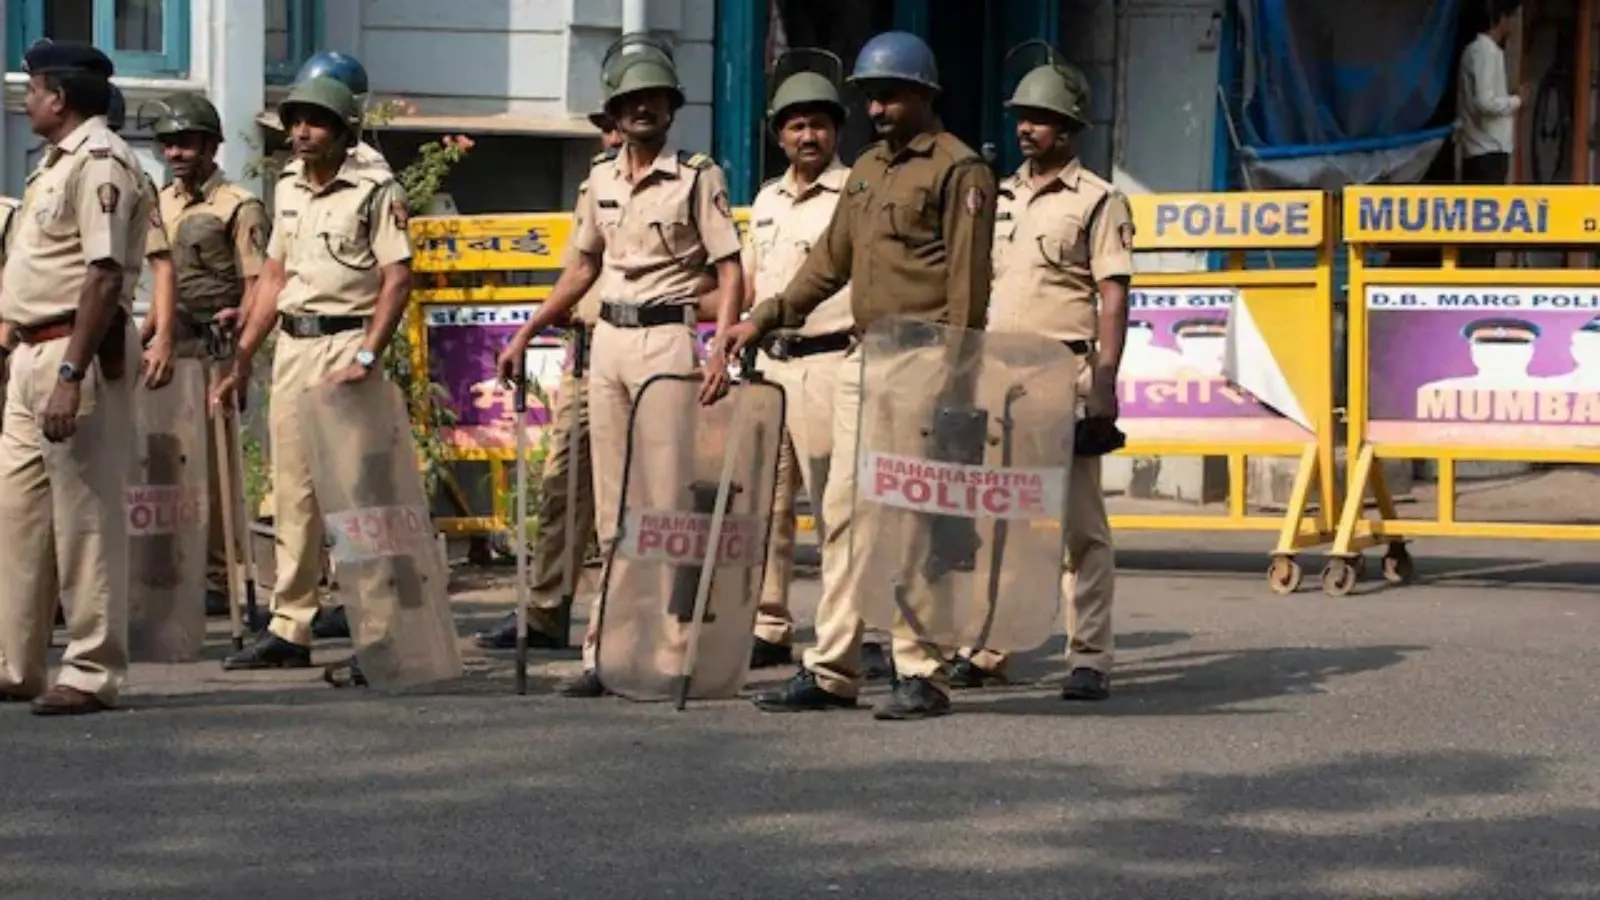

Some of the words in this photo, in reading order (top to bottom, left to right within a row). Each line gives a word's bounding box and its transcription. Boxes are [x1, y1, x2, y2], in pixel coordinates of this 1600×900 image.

[1155, 202, 1310, 237] POLICE
[1359, 197, 1549, 233] MUMBAI
[1437, 294, 1521, 306] MARG
[875, 456, 1043, 488] MAHARASHTRA
[874, 472, 1045, 514] POLICE
[637, 529, 752, 560] POLIC
